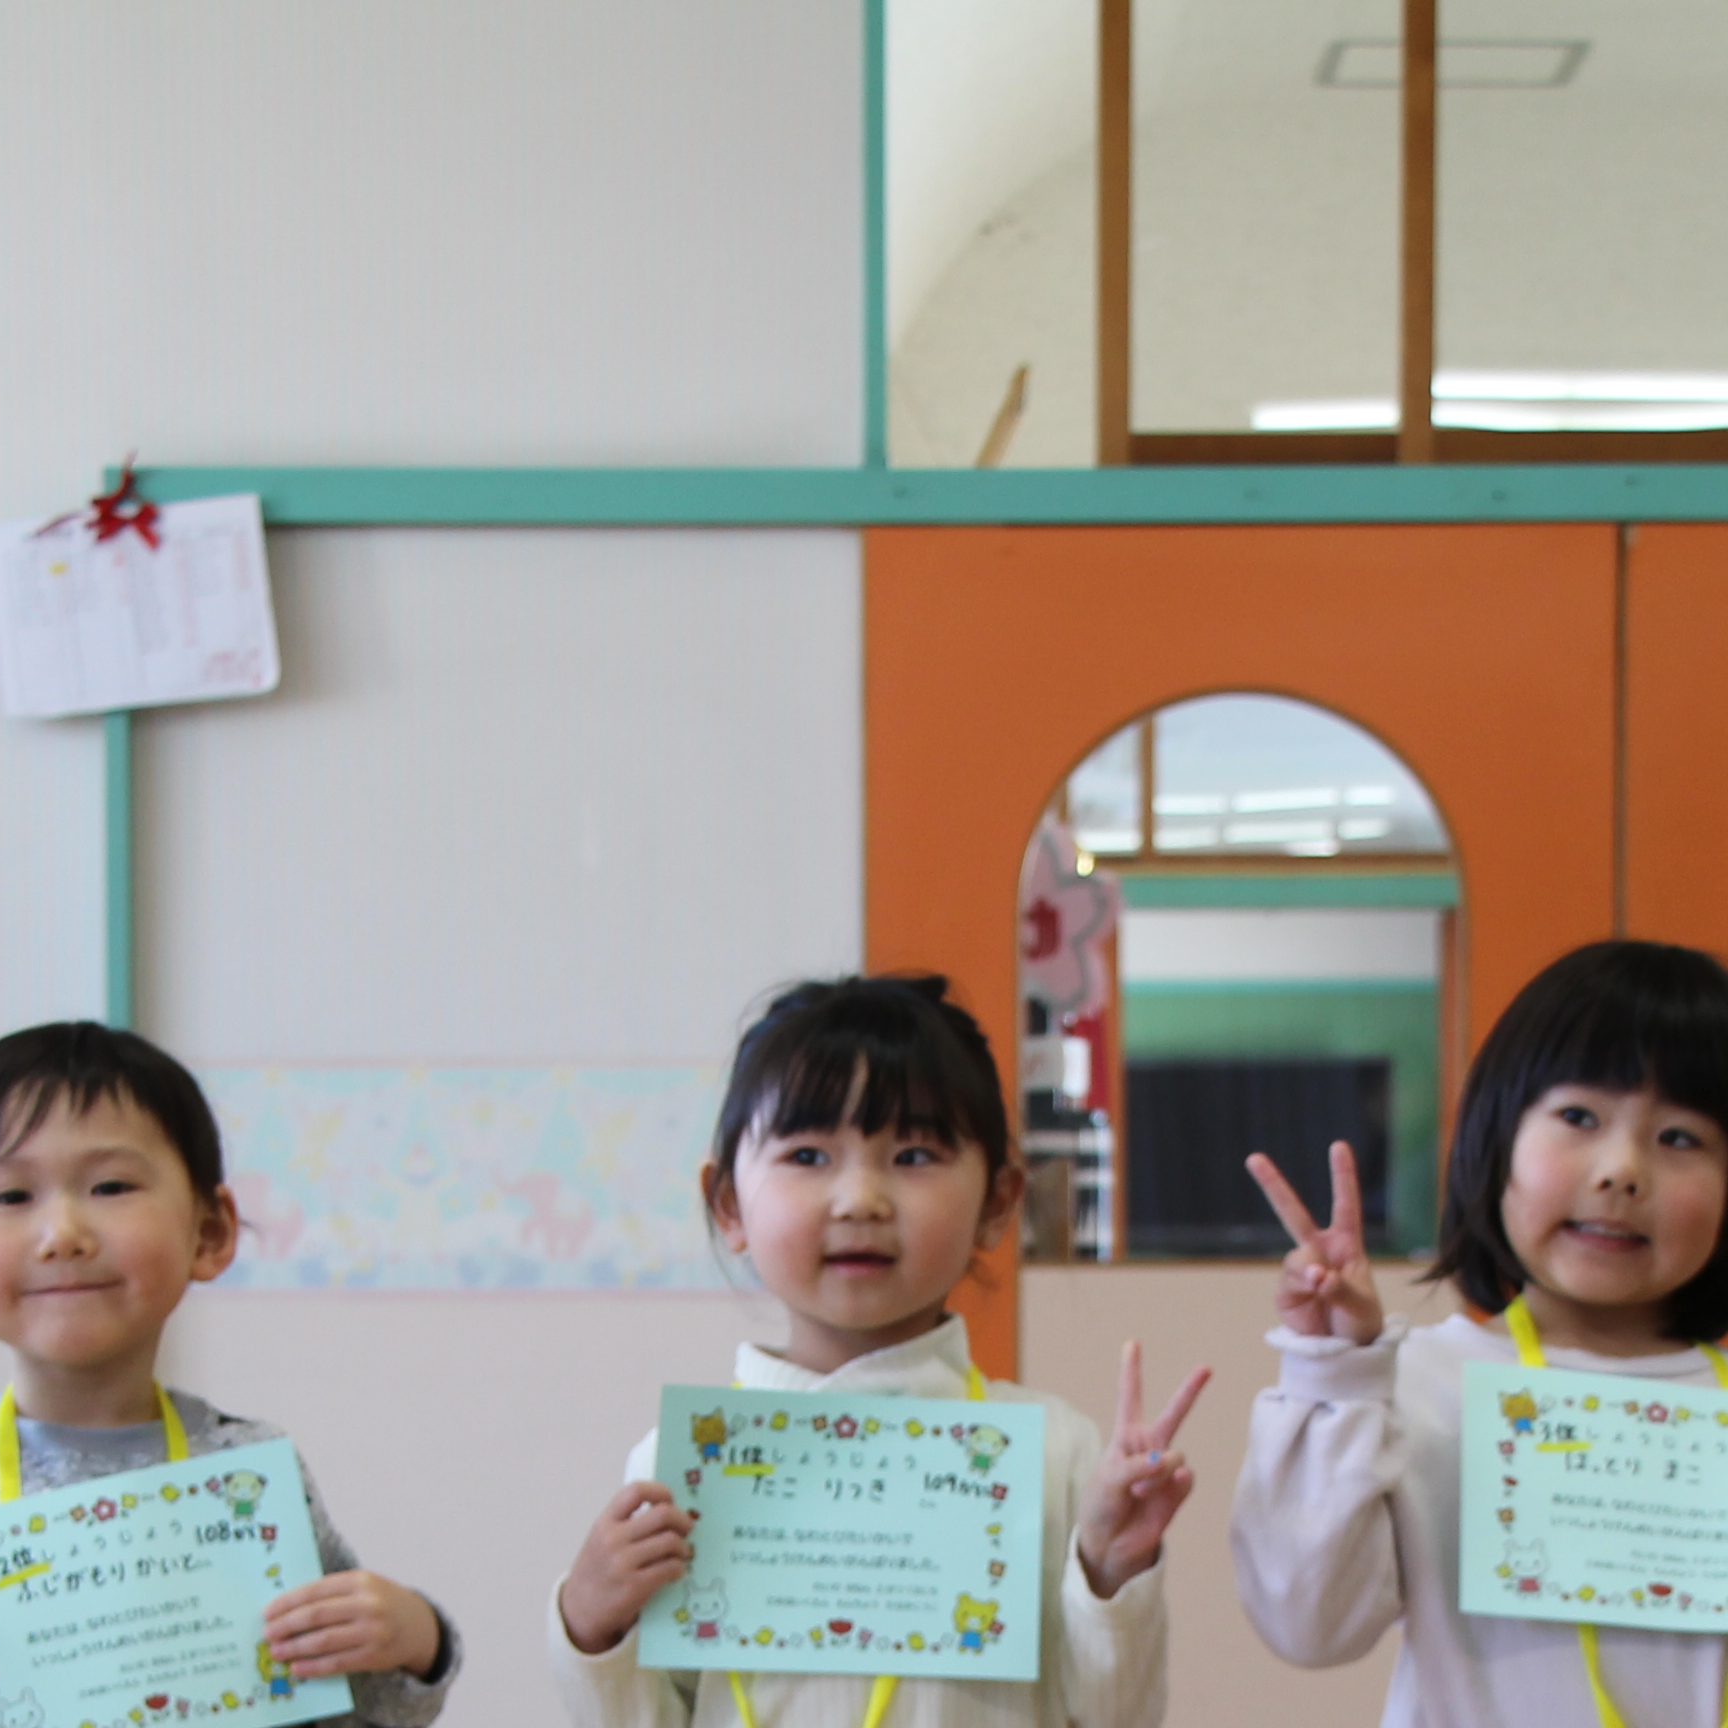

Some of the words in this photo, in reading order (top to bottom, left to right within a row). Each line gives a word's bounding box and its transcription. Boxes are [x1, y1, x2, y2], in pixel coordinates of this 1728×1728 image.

[1540, 1422, 1576, 1442] 3位
[1587, 1427, 1726, 1454] しょうじょう
[729, 1446, 763, 1465] 1位
[773, 1448, 916, 1470] しょうじょう
[42, 1520, 182, 1562] しょうじょう
